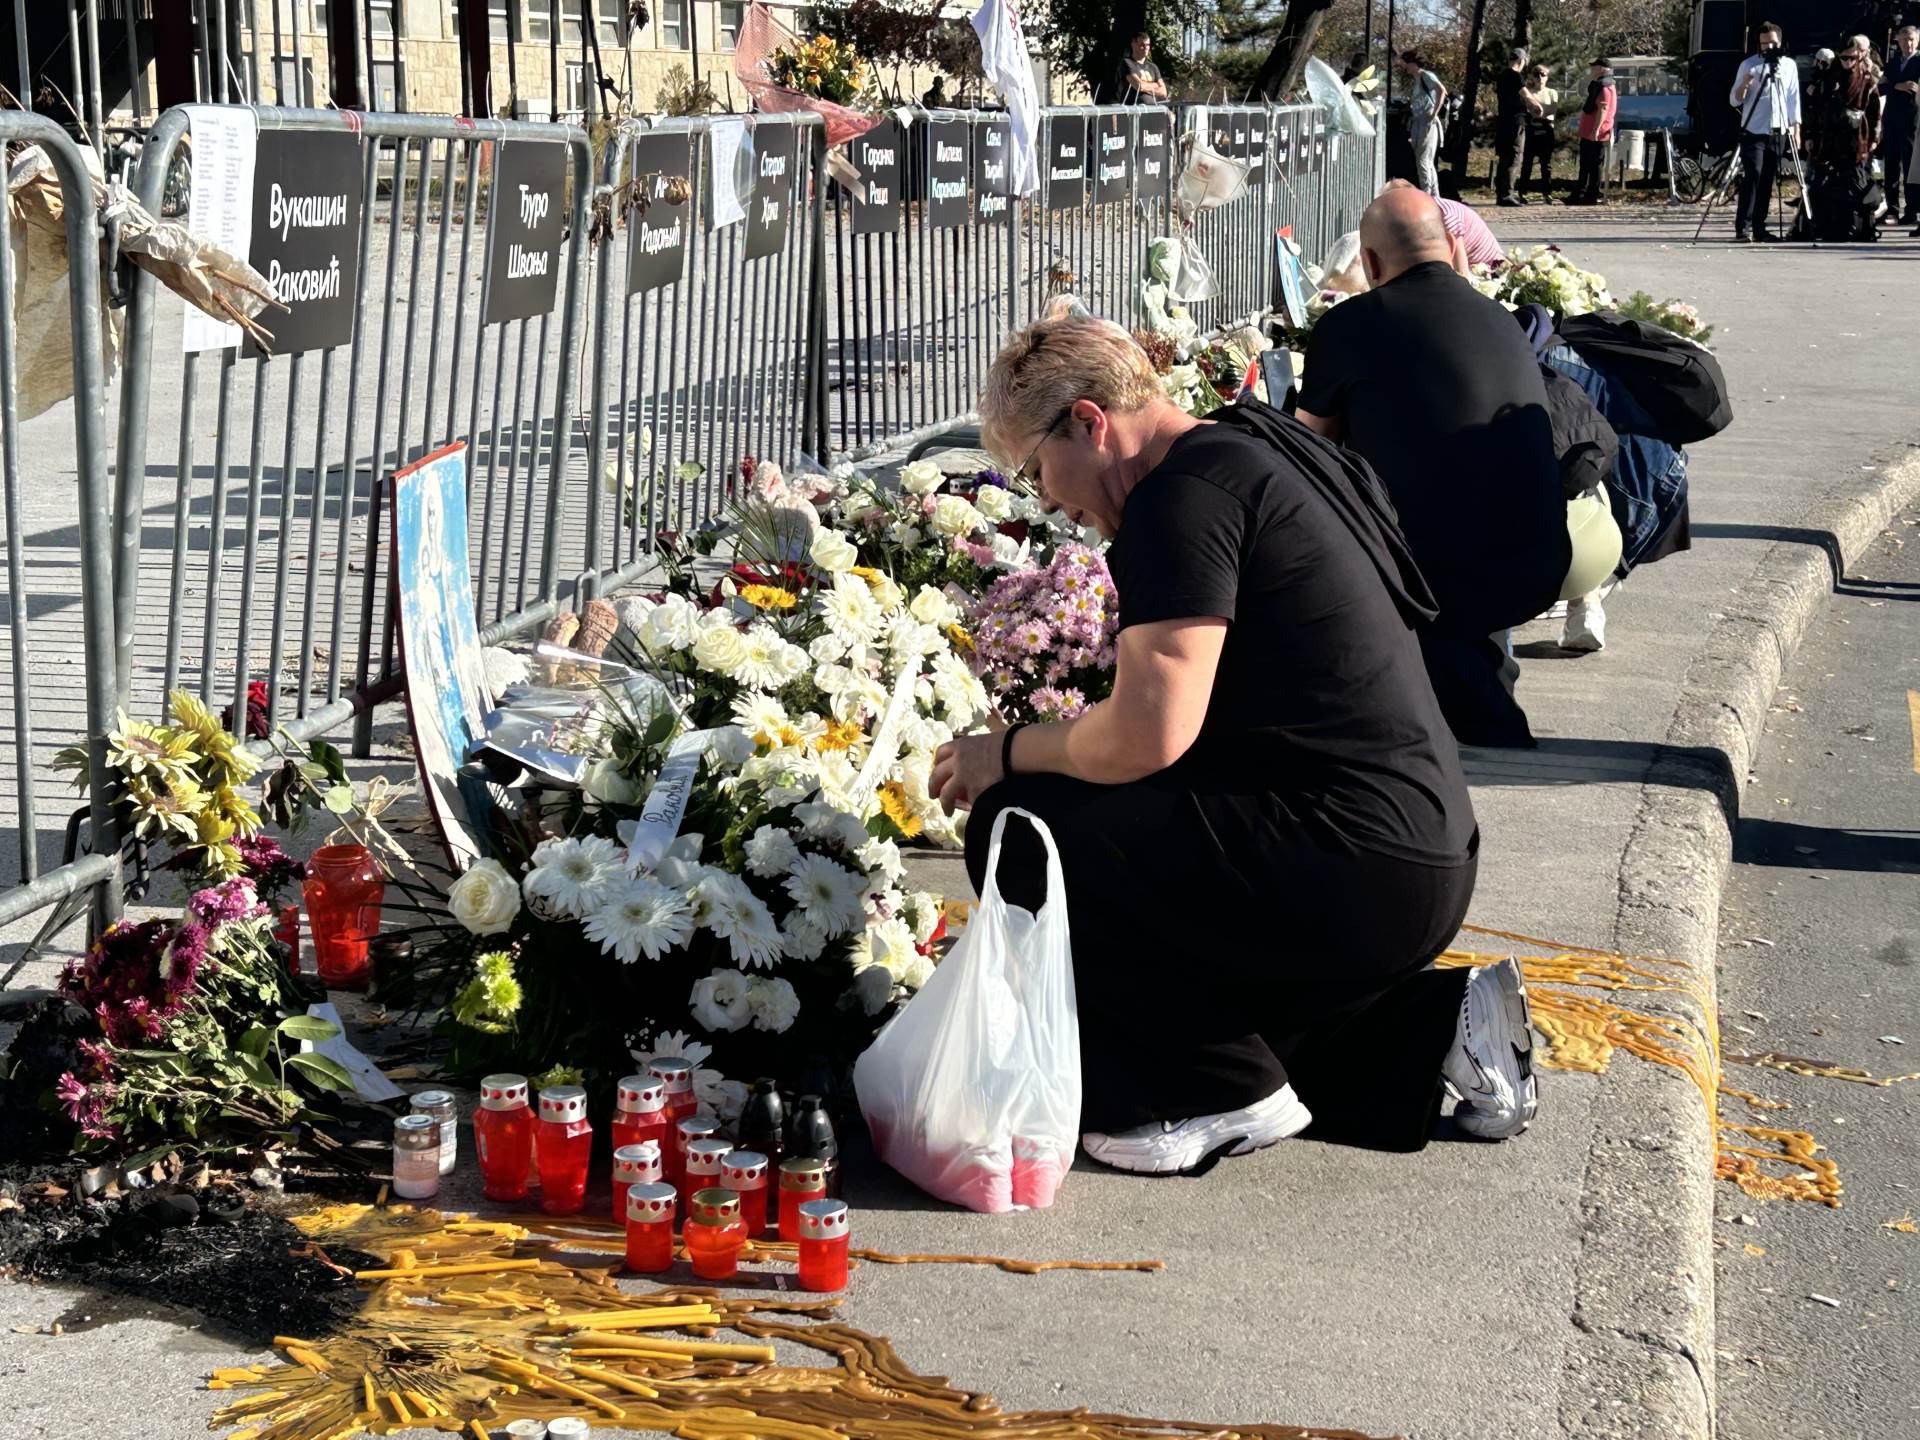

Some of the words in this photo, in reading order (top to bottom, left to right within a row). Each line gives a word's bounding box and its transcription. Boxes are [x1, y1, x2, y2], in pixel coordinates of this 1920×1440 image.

[862, 142, 895, 173] Горанка
[269, 183, 347, 242] Вукашин
[518, 183, 549, 230] Ђуро
[869, 180, 889, 206] Раца
[640, 215, 681, 256] Радоњић
[268, 254, 340, 303] Раковић
[508, 244, 549, 279] Швоња
